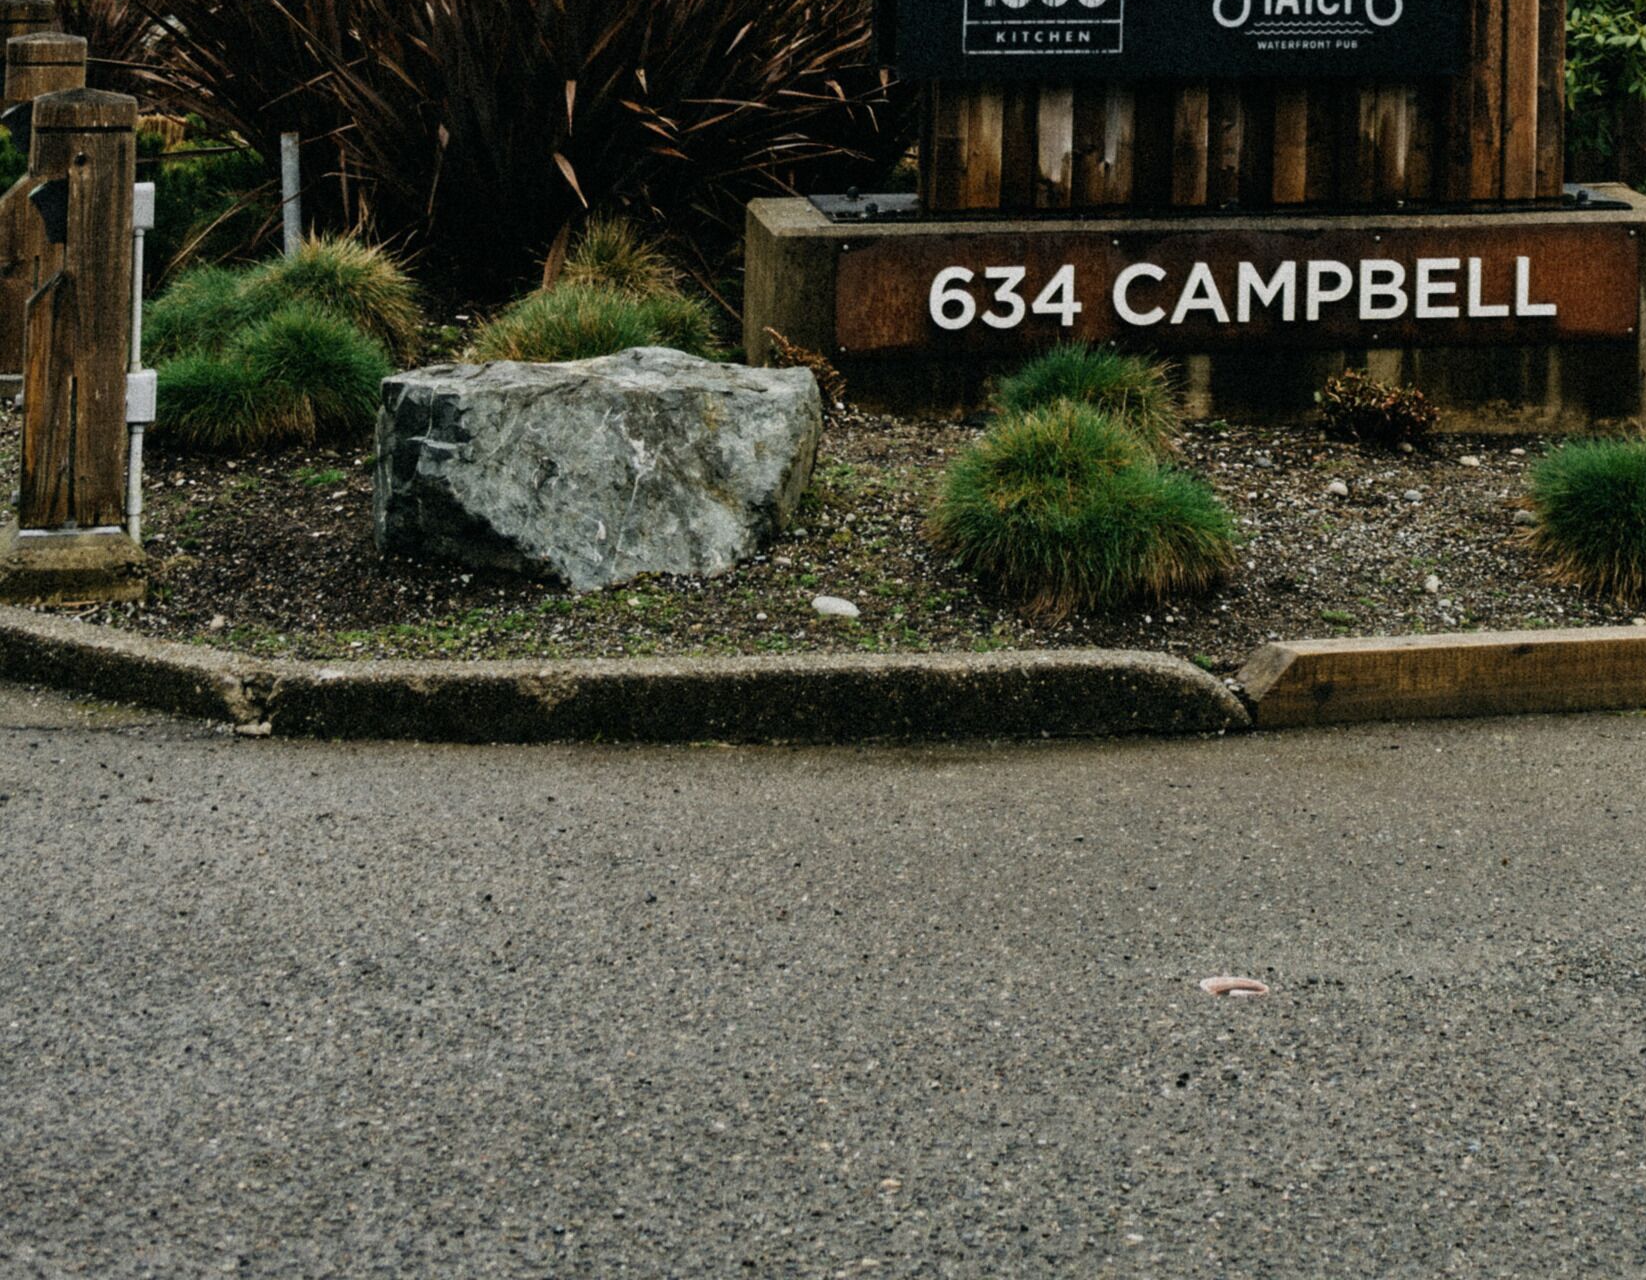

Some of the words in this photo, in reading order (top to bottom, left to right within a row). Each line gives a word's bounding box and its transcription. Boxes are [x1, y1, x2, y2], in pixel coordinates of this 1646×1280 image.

[996, 31, 1090, 43] KITCHEN
[1257, 40, 1331, 50] WATERFRONT
[1335, 40, 1358, 50] PUB
[928, 264, 1083, 330] 634
[1112, 255, 1558, 326] CAMPBELL
